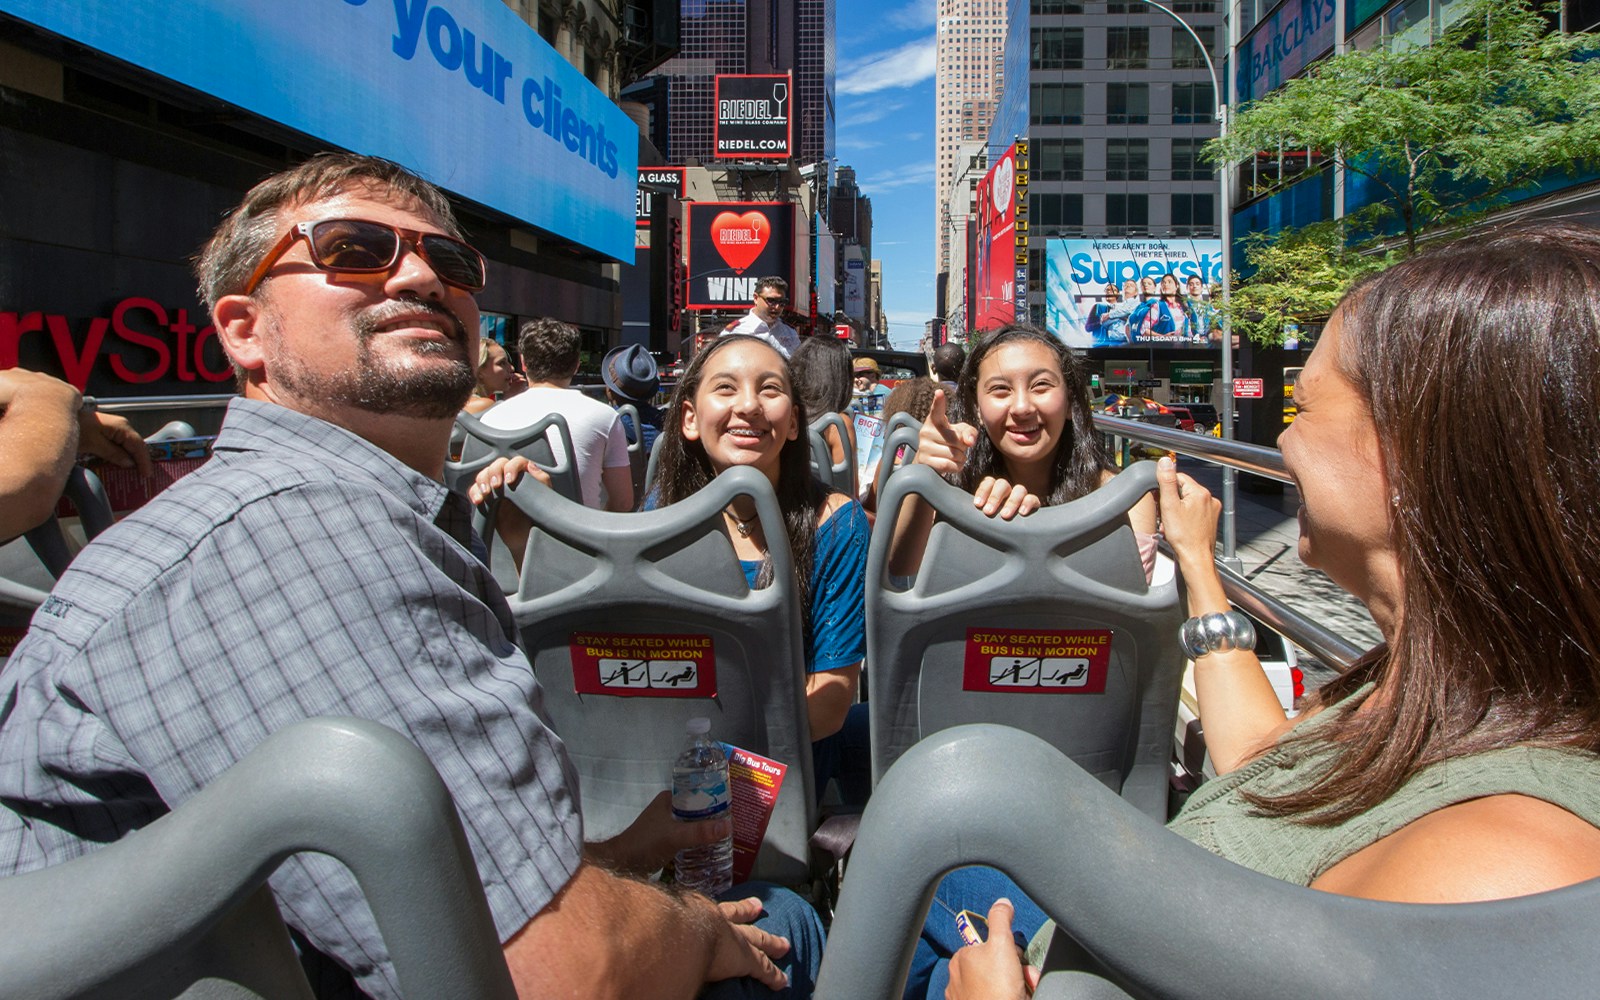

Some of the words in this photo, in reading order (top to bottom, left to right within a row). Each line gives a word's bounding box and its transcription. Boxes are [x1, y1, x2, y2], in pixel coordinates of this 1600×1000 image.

[1251, 0, 1336, 85] BARCLAYS
[392, 0, 513, 105] your
[521, 75, 619, 180] clients
[719, 99, 772, 120] RIEDEL
[718, 140, 787, 150] RIEDEL.COM
[638, 174, 646, 183] A
[648, 173, 680, 185] GLASS,
[1093, 242, 1120, 250] HEROES
[1122, 242, 1146, 250] AREN'T
[1149, 242, 1170, 250] BORN.
[1134, 250, 1163, 259] THEY'RE
[1166, 251, 1188, 259] HIRED.
[858, 418, 873, 428] BIG
[577, 637, 608, 645] STAY
[612, 638, 664, 647] SEATED
[668, 638, 710, 648] WHILE
[973, 634, 1006, 643] STAY
[1009, 635, 1062, 644] SEATED
[1065, 635, 1107, 645] WHILE
[586, 648, 613, 656] BUS
[617, 649, 629, 657] IS
[633, 650, 646, 658] IN
[650, 649, 703, 659] MOTION
[980, 645, 1008, 655] BUS
[1011, 647, 1024, 655] IS
[1027, 647, 1042, 656] IN
[1045, 647, 1098, 656] MOTION
[746, 756, 761, 769] Bus
[761, 761, 781, 775] Tours
